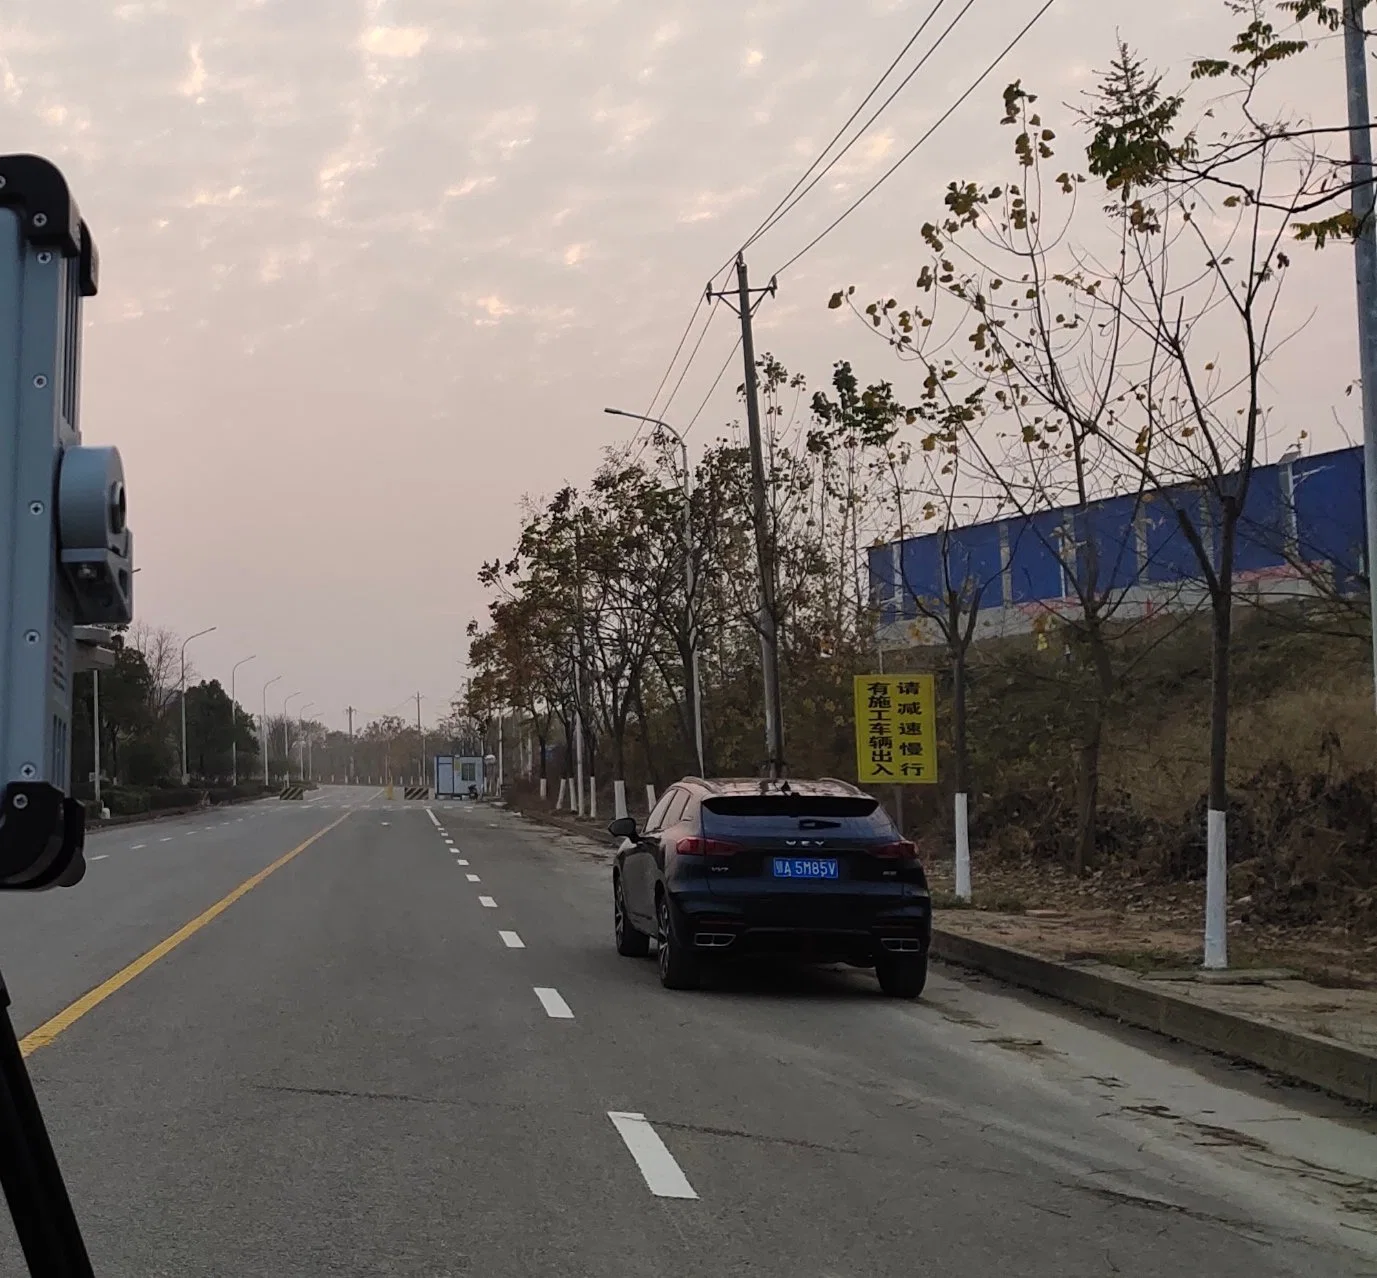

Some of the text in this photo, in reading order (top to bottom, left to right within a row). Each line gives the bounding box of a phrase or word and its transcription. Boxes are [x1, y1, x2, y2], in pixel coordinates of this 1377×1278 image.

[867, 682, 893, 776] 有施工车辆出入
[896, 682, 925, 776] 请减速慢行
